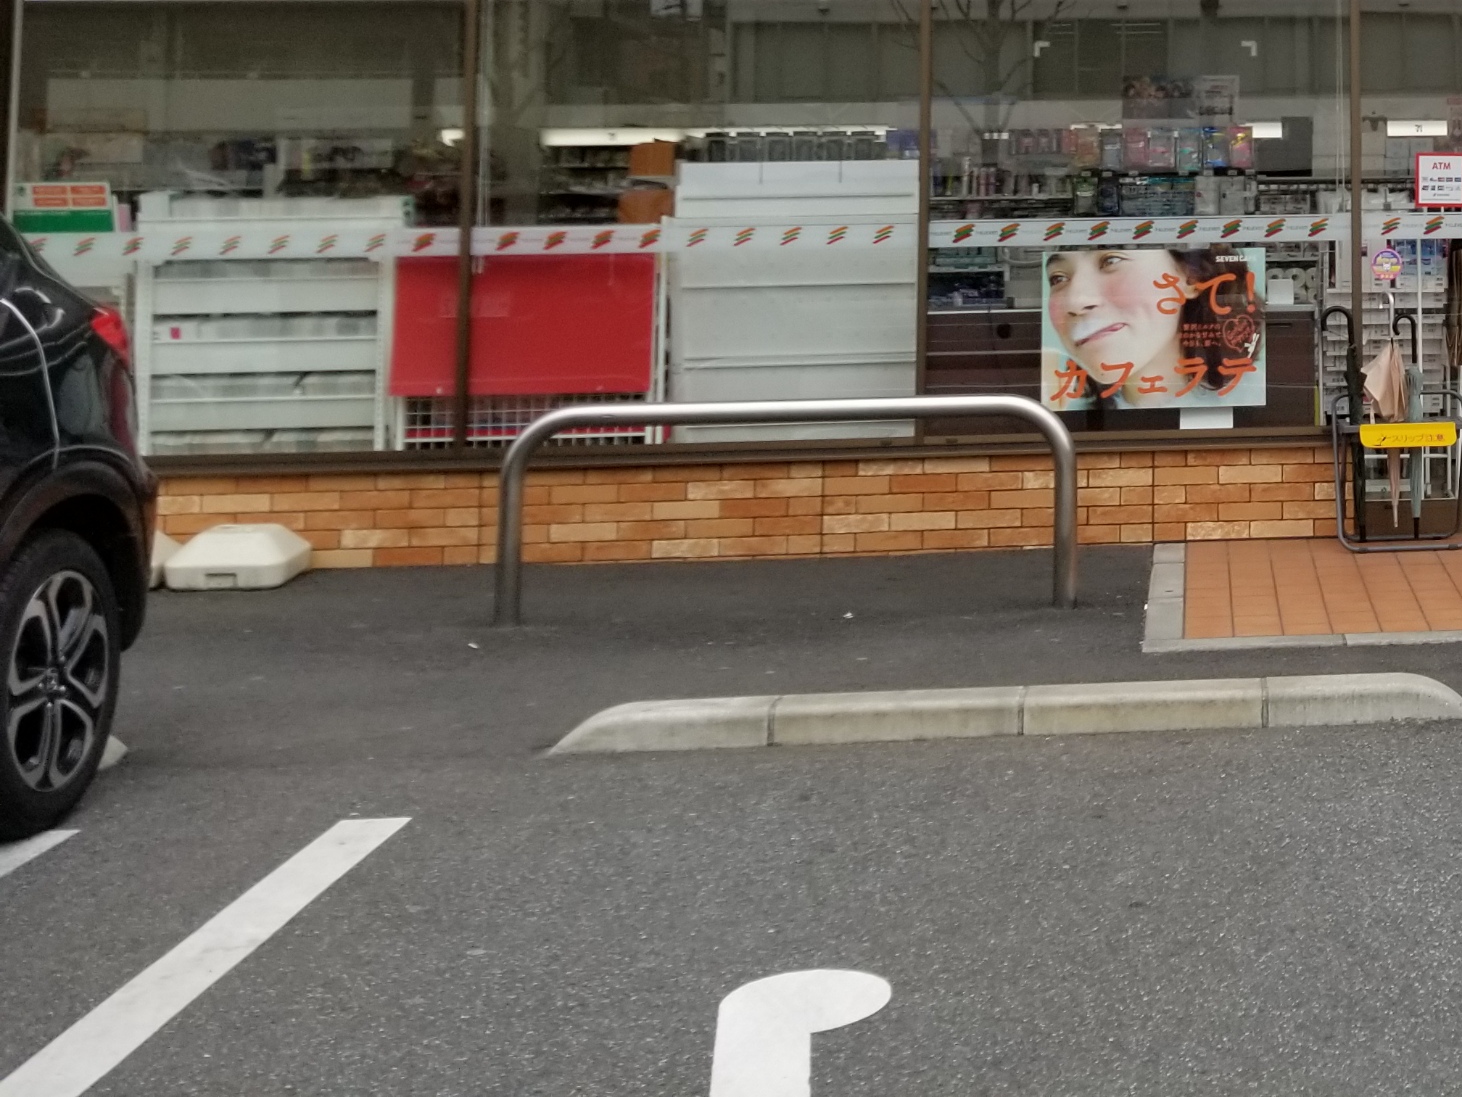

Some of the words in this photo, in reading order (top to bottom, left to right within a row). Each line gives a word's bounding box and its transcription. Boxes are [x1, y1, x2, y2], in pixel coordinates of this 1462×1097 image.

[1432, 162, 1451, 170] ATM
[1215, 255, 1239, 263] SEVEN
[1050, 356, 1257, 402] カフェラテ
